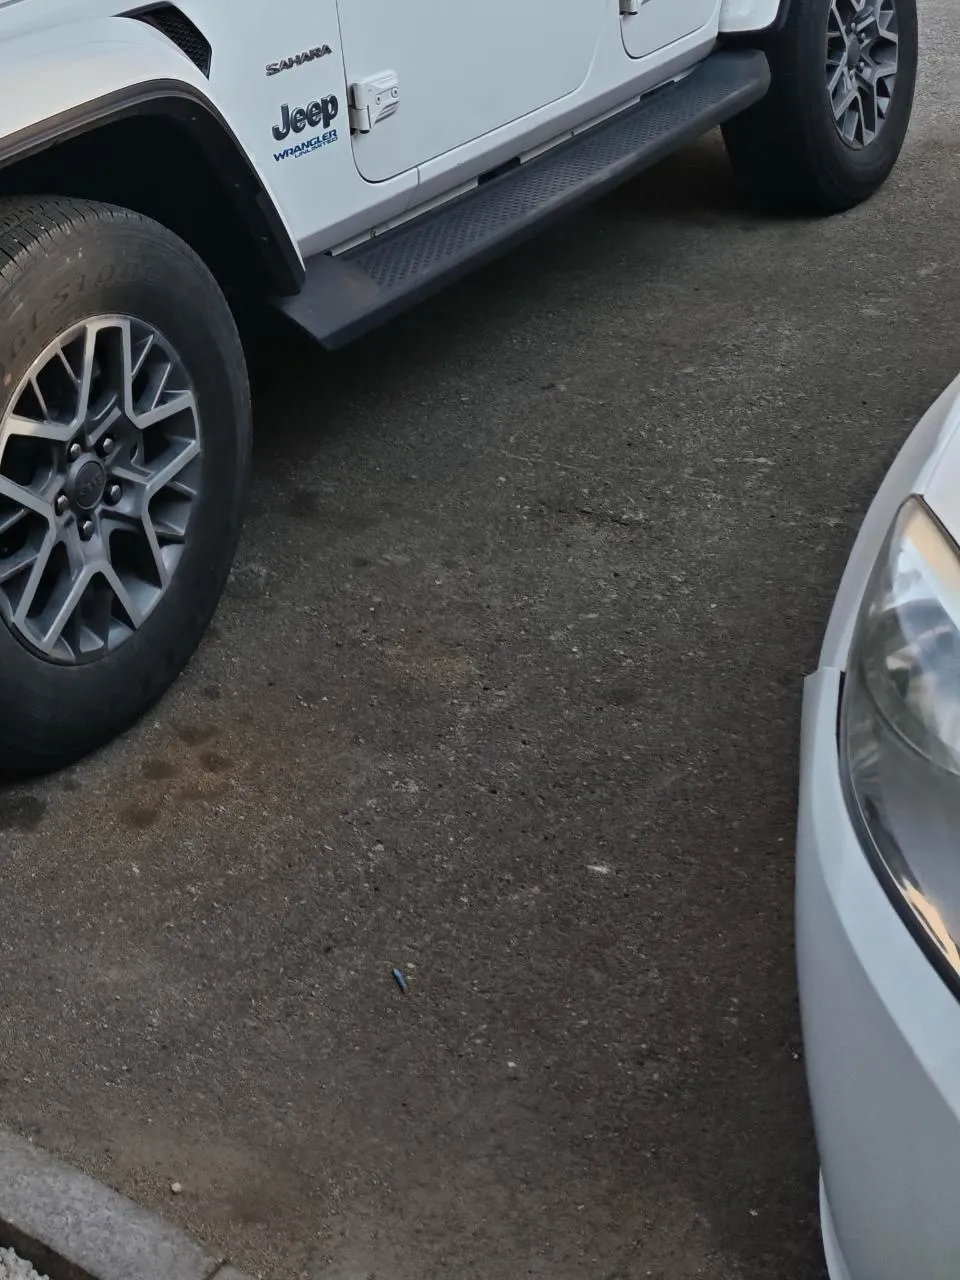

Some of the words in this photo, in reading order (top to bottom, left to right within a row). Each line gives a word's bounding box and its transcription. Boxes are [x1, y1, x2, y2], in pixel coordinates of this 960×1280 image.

[265, 43, 333, 77] SAHARA
[271, 93, 339, 141] Jeep
[273, 129, 338, 162] WRANGLER
[294, 136, 339, 159] UNLIMITED
